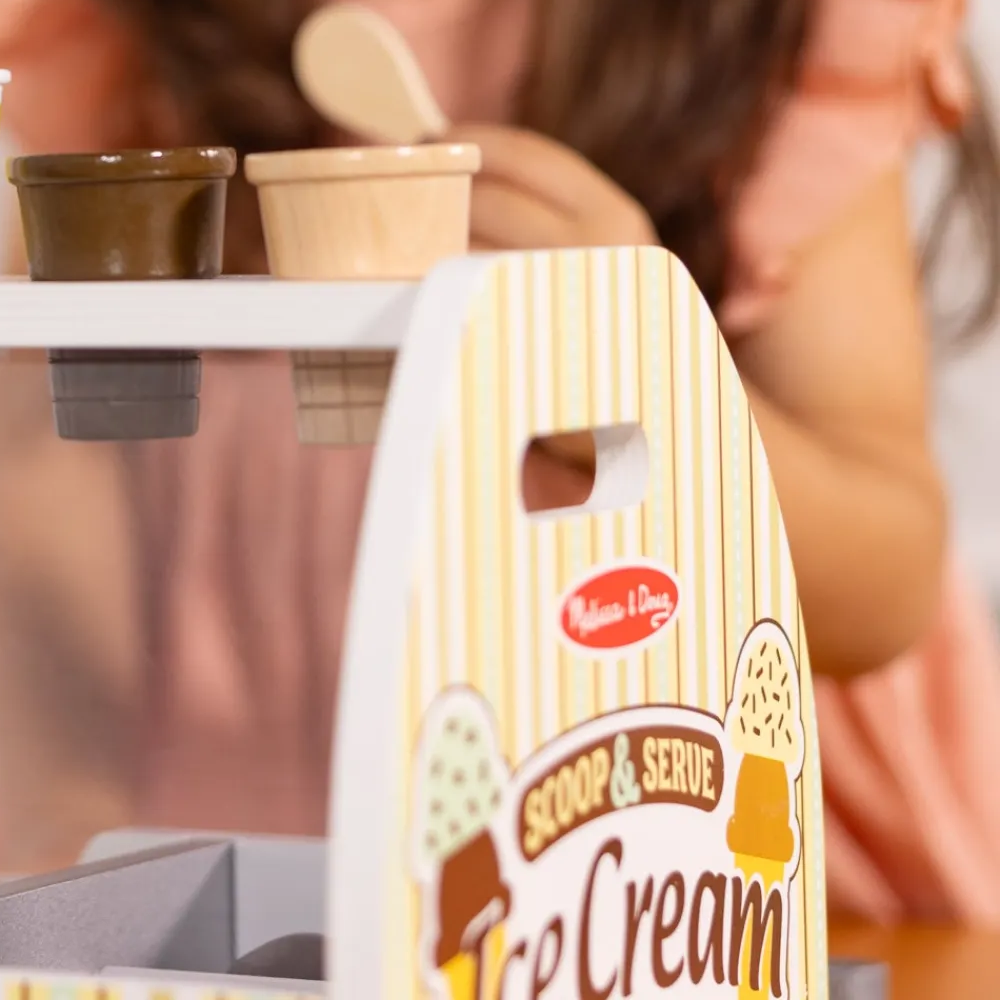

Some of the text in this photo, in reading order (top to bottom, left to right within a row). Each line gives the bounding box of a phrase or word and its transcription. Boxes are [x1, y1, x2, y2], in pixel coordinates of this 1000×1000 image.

[638, 584, 672, 628] Doug
[523, 733, 715, 854] SCOOP & SERVE
[578, 837, 783, 1000] Cream
